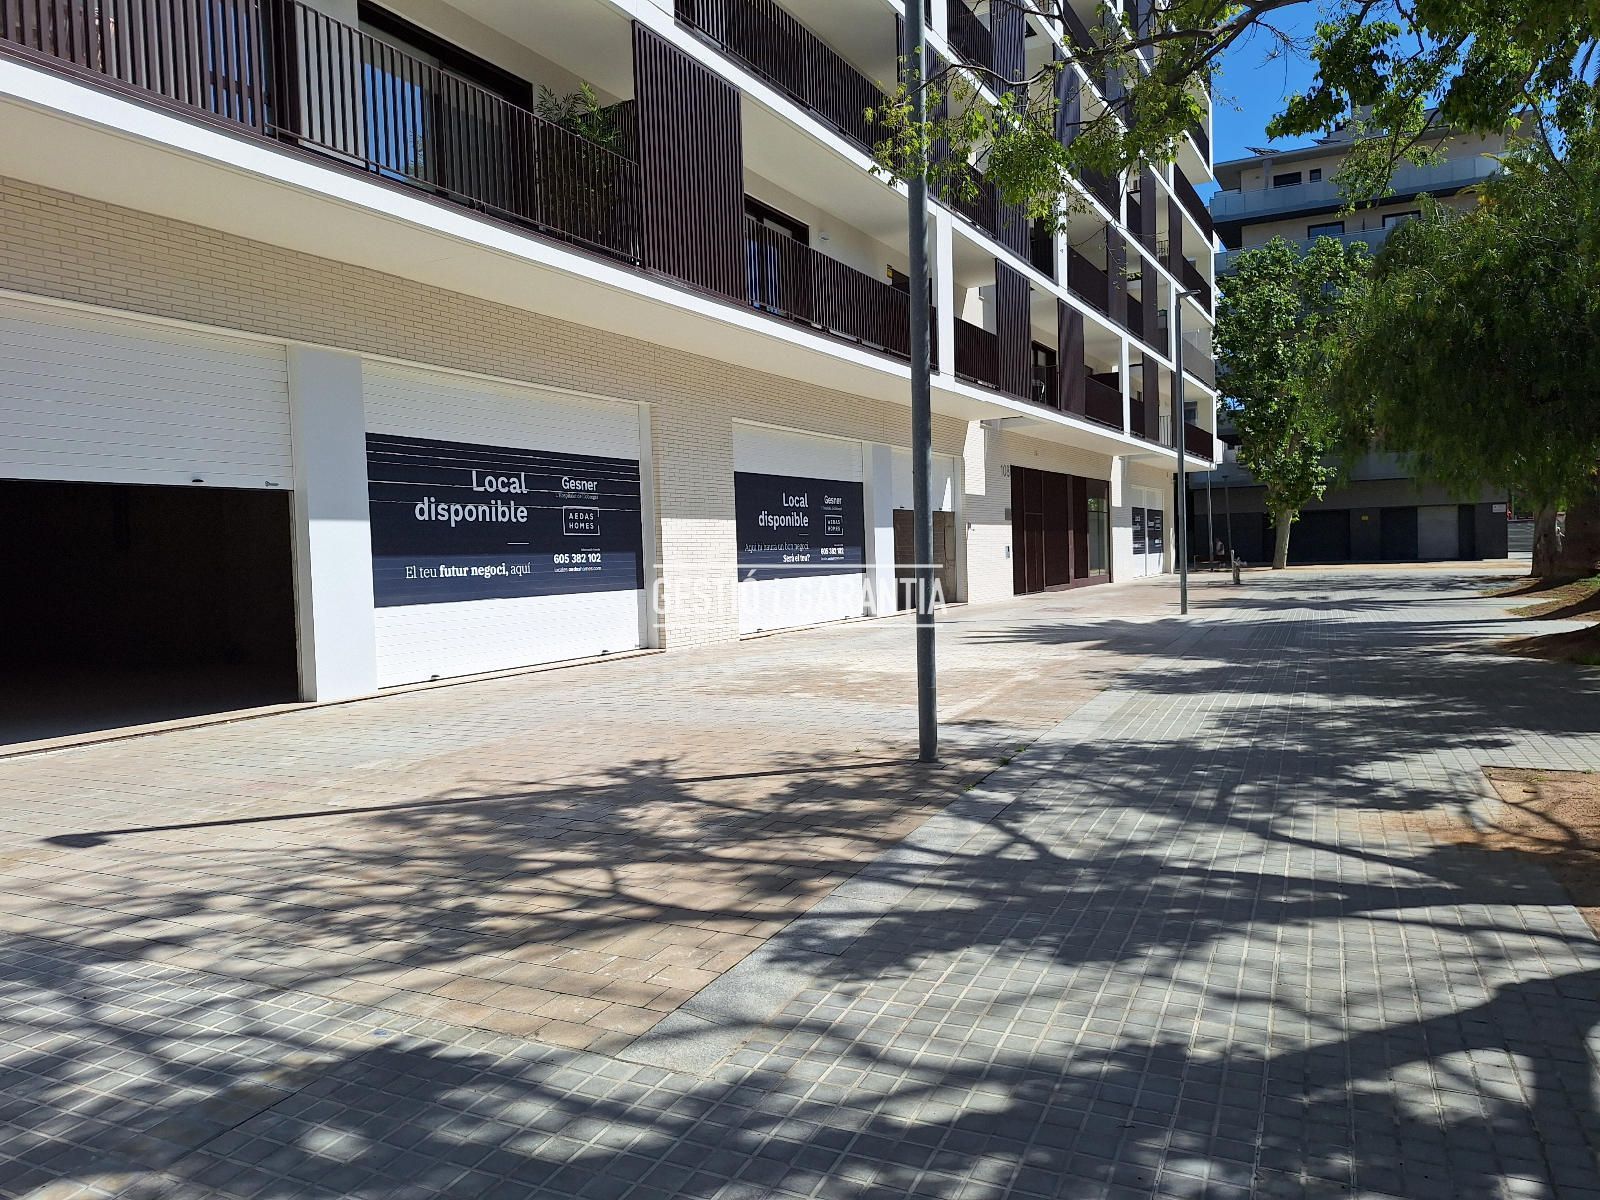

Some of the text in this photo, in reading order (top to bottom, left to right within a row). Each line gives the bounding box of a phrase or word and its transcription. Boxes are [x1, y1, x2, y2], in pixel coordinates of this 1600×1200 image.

[472, 470, 528, 494] Local
[561, 476, 598, 491] Gesner
[783, 492, 809, 508] Local
[415, 497, 528, 528] disponible
[568, 512, 594, 520] AEDAS
[758, 511, 809, 530] disponible
[568, 522, 594, 530] HOMES
[553, 553, 601, 564] 605 382 102
[405, 562, 531, 579] El teu futur negoci, aquí
